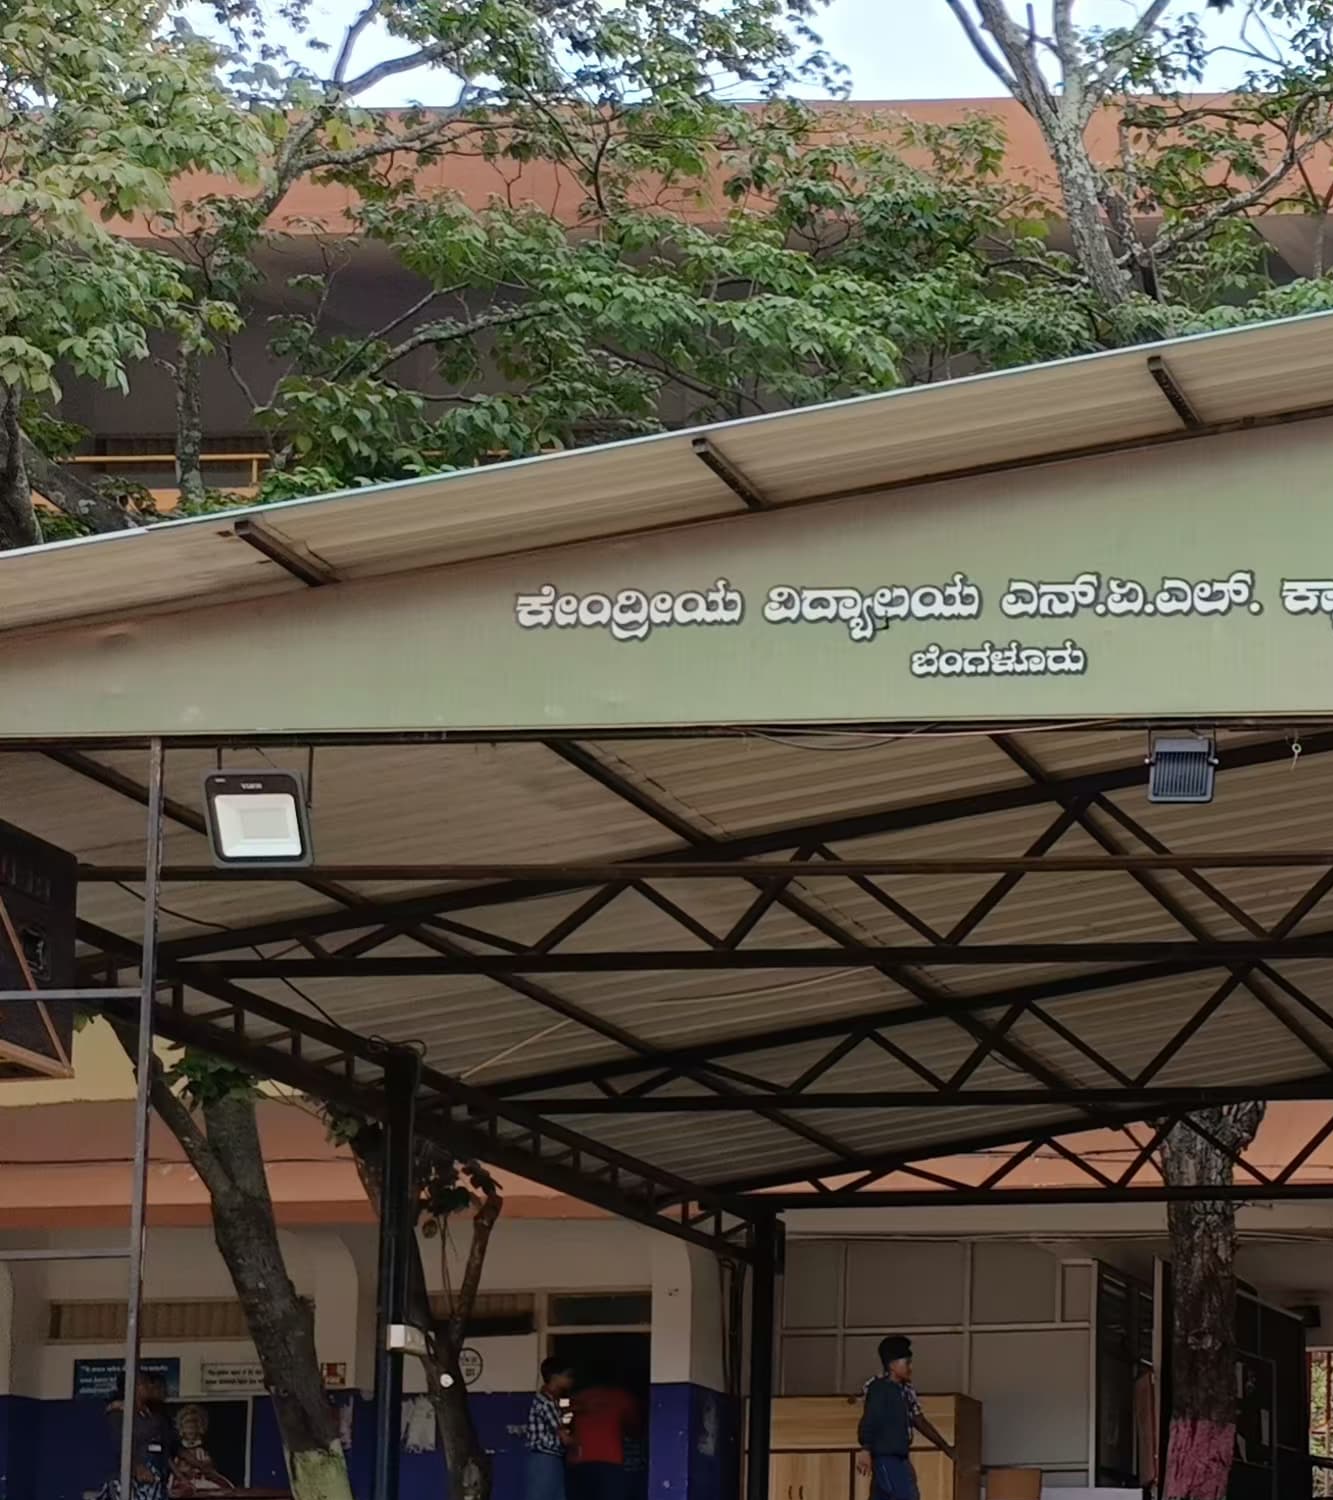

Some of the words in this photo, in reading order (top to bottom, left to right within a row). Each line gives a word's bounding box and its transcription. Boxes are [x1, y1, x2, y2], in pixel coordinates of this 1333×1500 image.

[515, 577, 745, 642] ಕೇಂದ್ರೀಯ
[763, 571, 982, 642] ವಿದ್ಯಾಲಯ
[910, 637, 1088, 678] ಬೆಂಗಳೂರು
